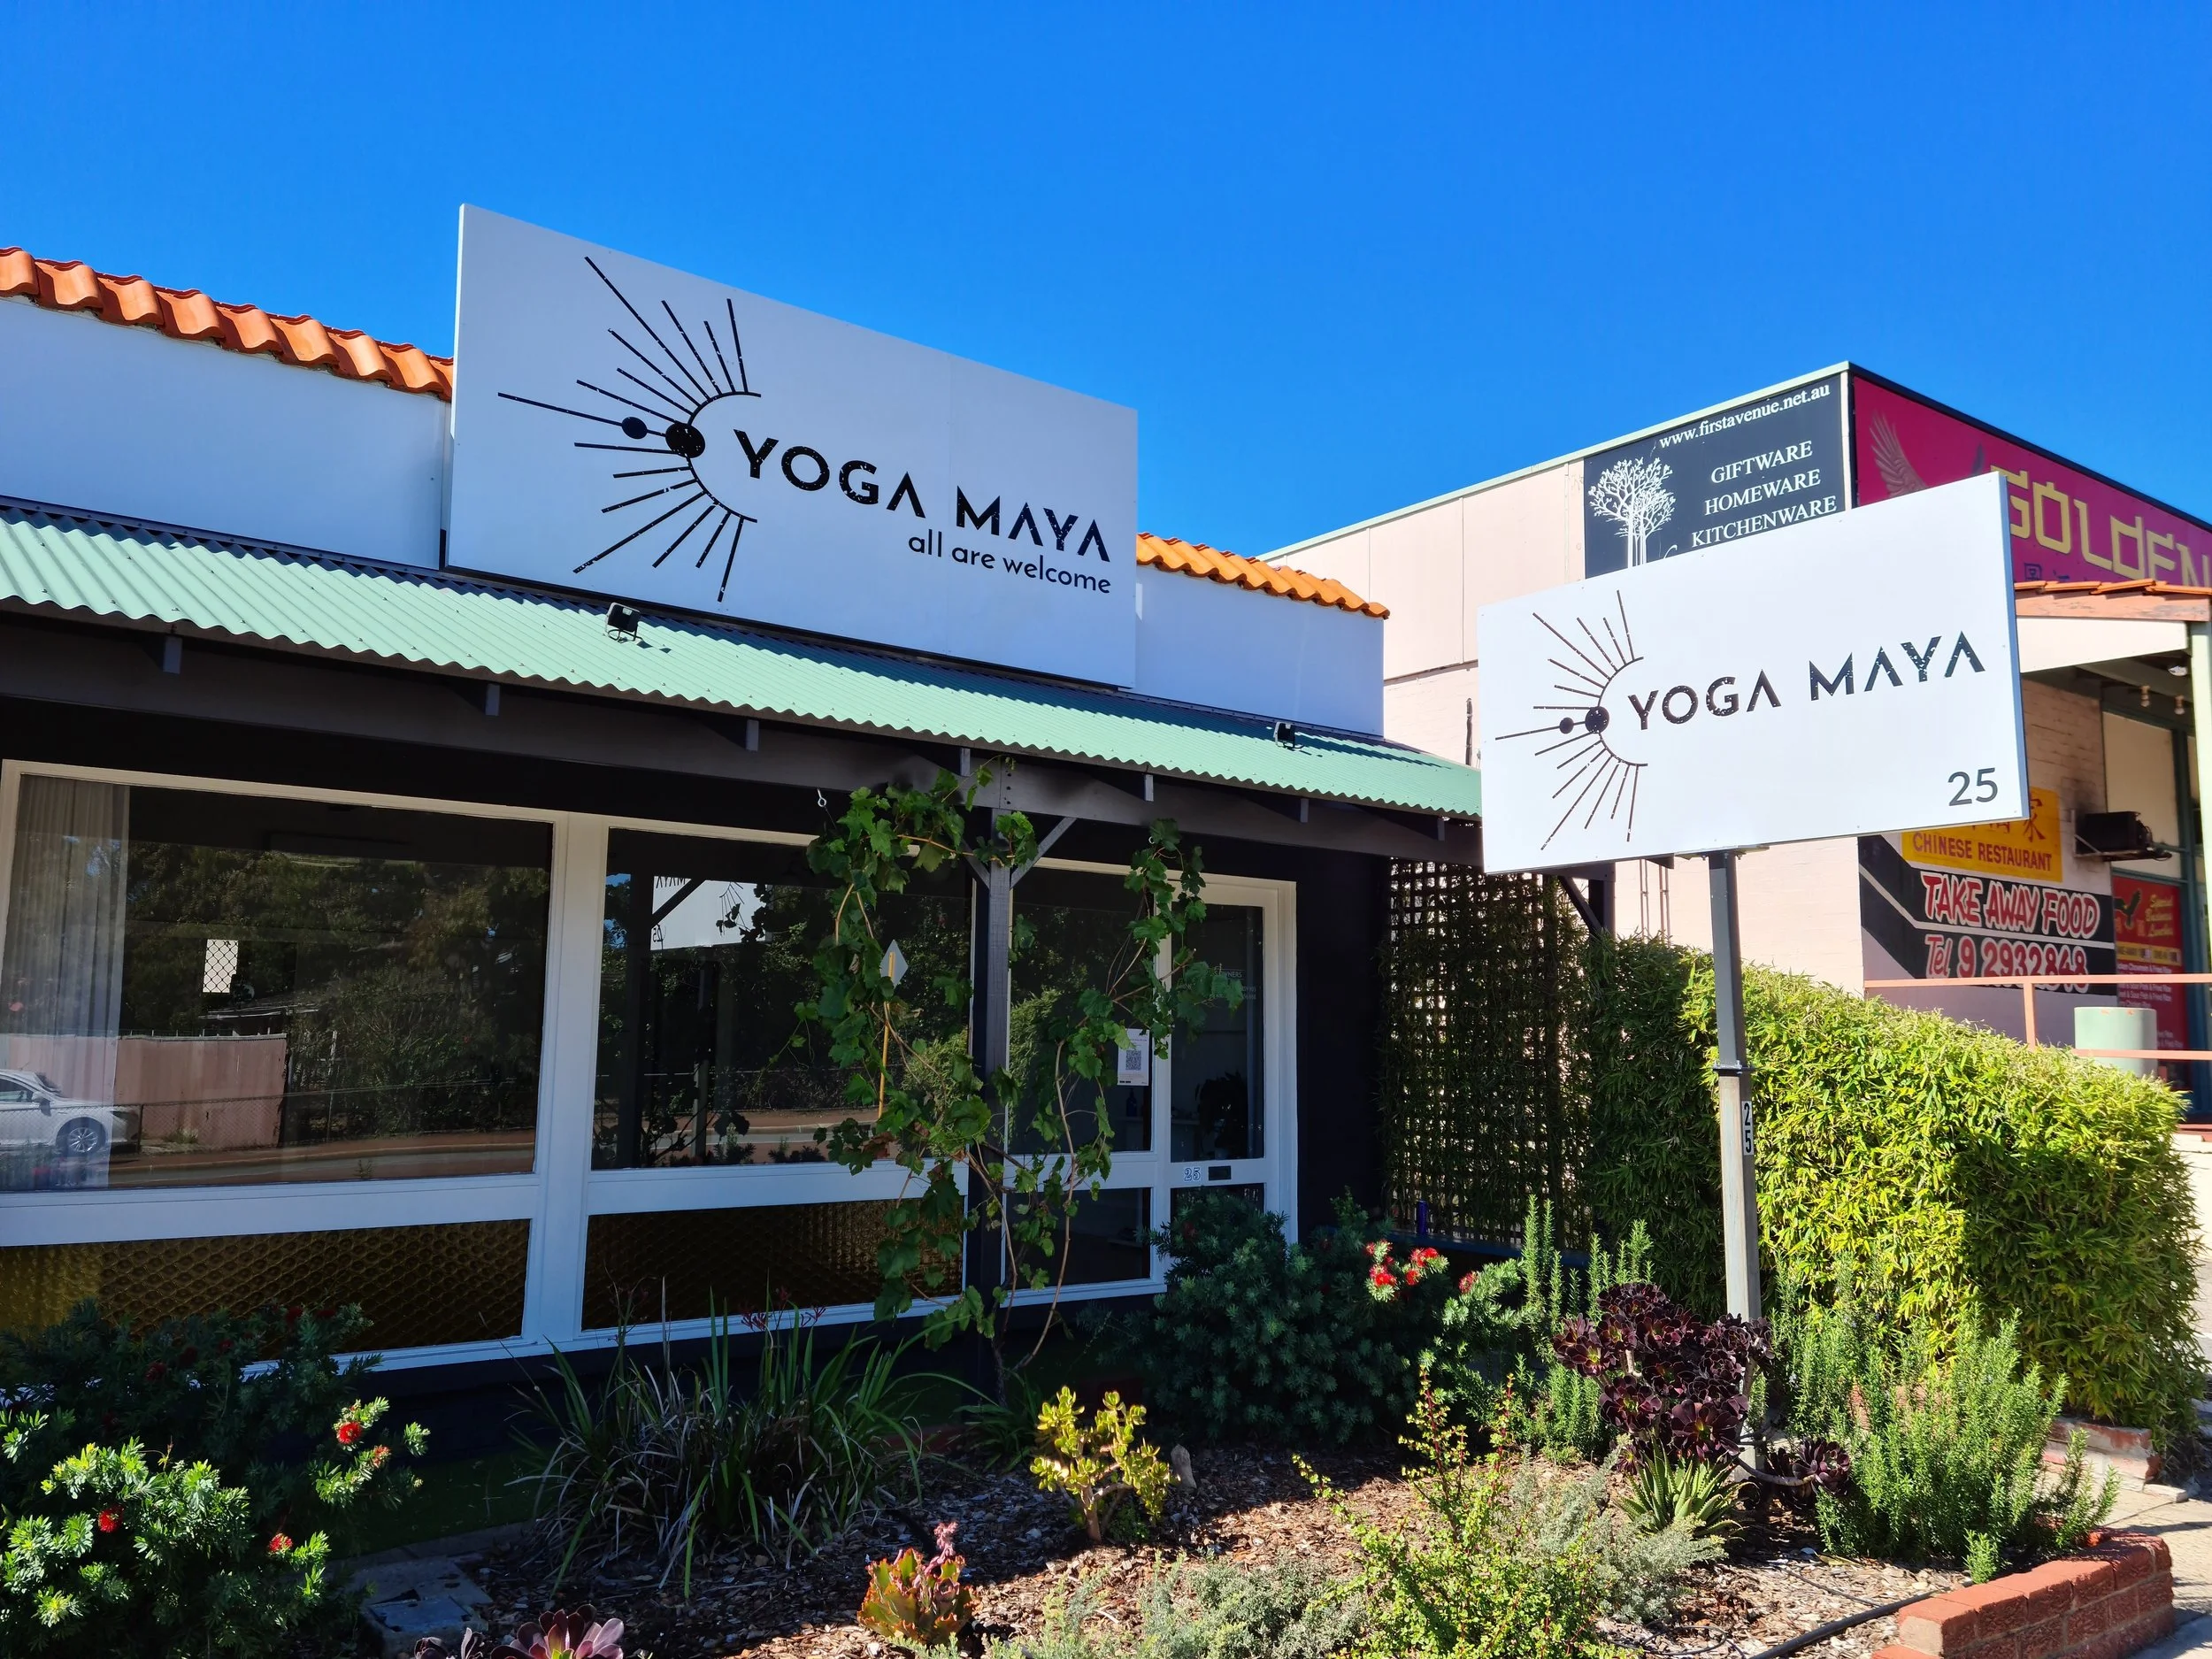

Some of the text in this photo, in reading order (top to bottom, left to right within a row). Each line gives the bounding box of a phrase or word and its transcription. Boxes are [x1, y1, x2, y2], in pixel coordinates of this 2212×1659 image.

[1659, 384, 1830, 449] www.firstavenue.net.au
[1710, 440, 1813, 484] GIFTWARE
[733, 428, 1111, 563] YOGA MAYA
[1704, 468, 1821, 516] HOMEWARE
[1691, 495, 1837, 548] KITCHENWARE
[908, 528, 1111, 594] all are welcome
[1627, 629, 1985, 731] YOGA MAYA
[1947, 767, 1999, 807] 25
[1912, 831, 2053, 872] CHINESE RESTAURANT
[1920, 872, 2101, 940] TAKE AWAY FOOD
[1924, 933, 1953, 978] Tel
[1957, 935, 1977, 978] 9
[1743, 1102, 1752, 1154] 25
[1184, 1167, 1202, 1181] 25
